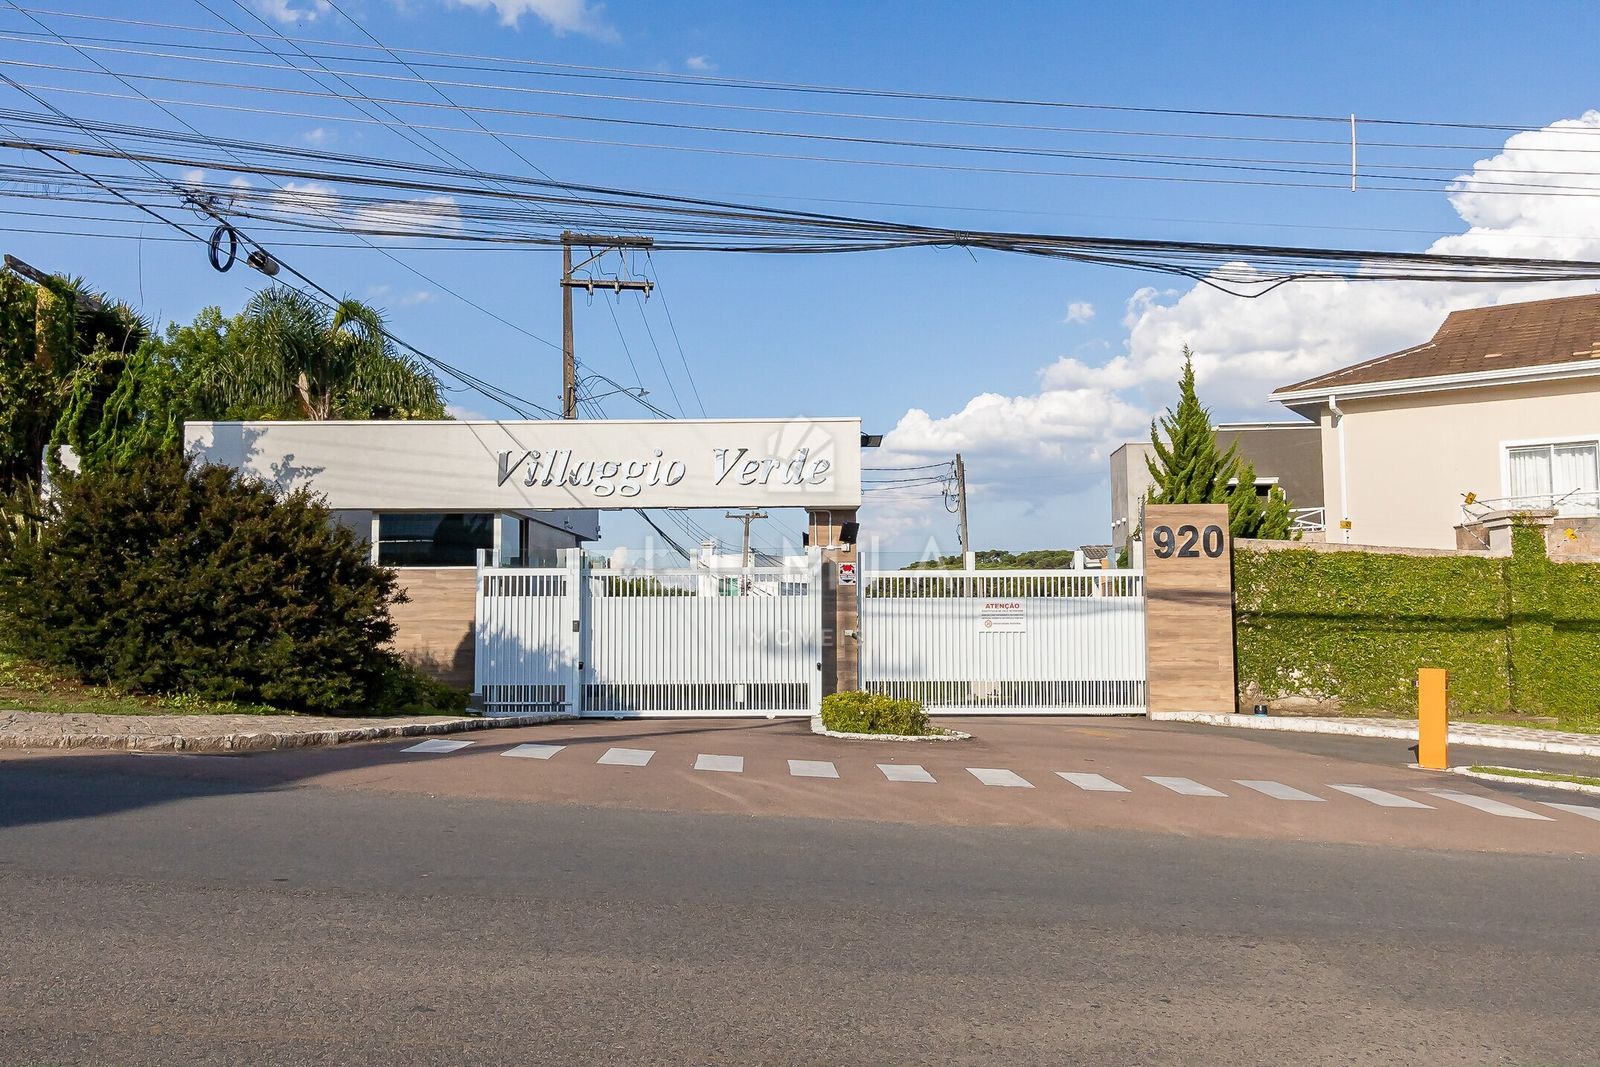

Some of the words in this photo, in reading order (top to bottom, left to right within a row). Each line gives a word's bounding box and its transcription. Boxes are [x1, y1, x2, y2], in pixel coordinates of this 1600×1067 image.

[497, 449, 686, 497] Villaggio
[713, 448, 831, 486] Verde
[1152, 525, 1224, 559] 920
[985, 602, 1020, 610] ATENÇÃO
